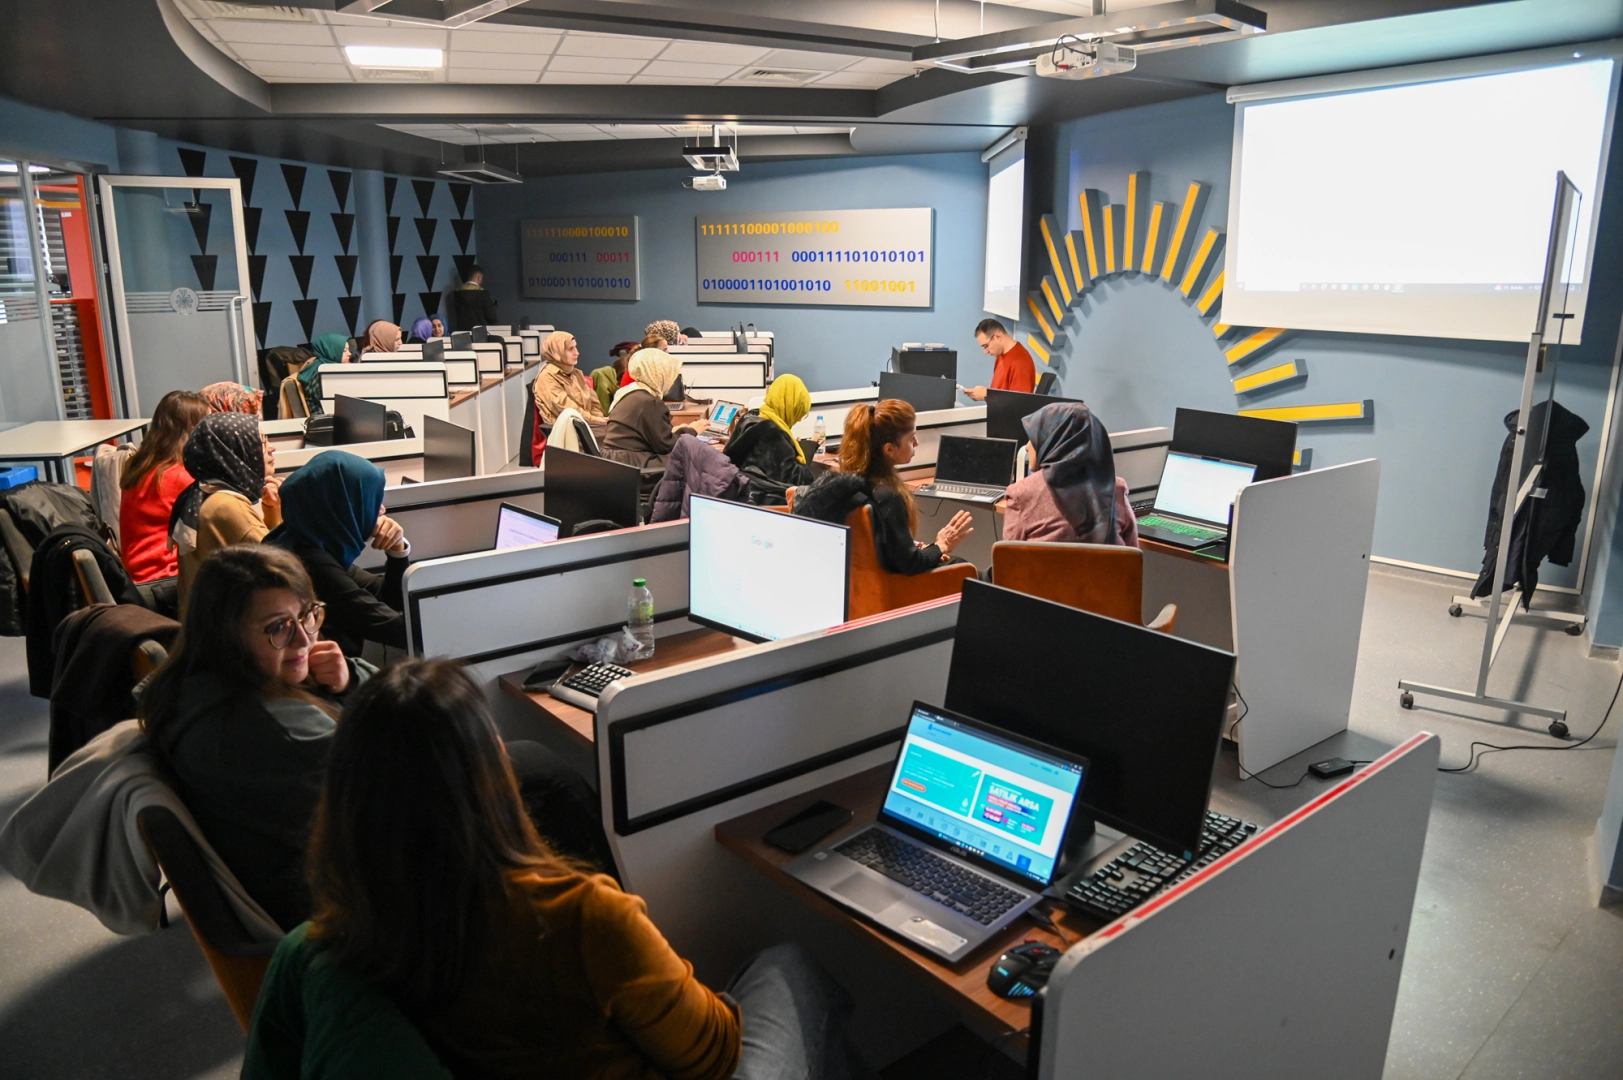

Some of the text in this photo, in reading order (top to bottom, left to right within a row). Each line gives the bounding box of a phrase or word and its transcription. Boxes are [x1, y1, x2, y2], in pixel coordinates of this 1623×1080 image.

[701, 221, 839, 236] 11111100001000100
[549, 252, 630, 263] 000111 00011
[732, 250, 925, 263] 000111 000111101010101
[528, 277, 631, 289] 0100001101001010
[702, 279, 916, 293] 0100001101001010 11001001
[751, 535, 774, 550] Goge
